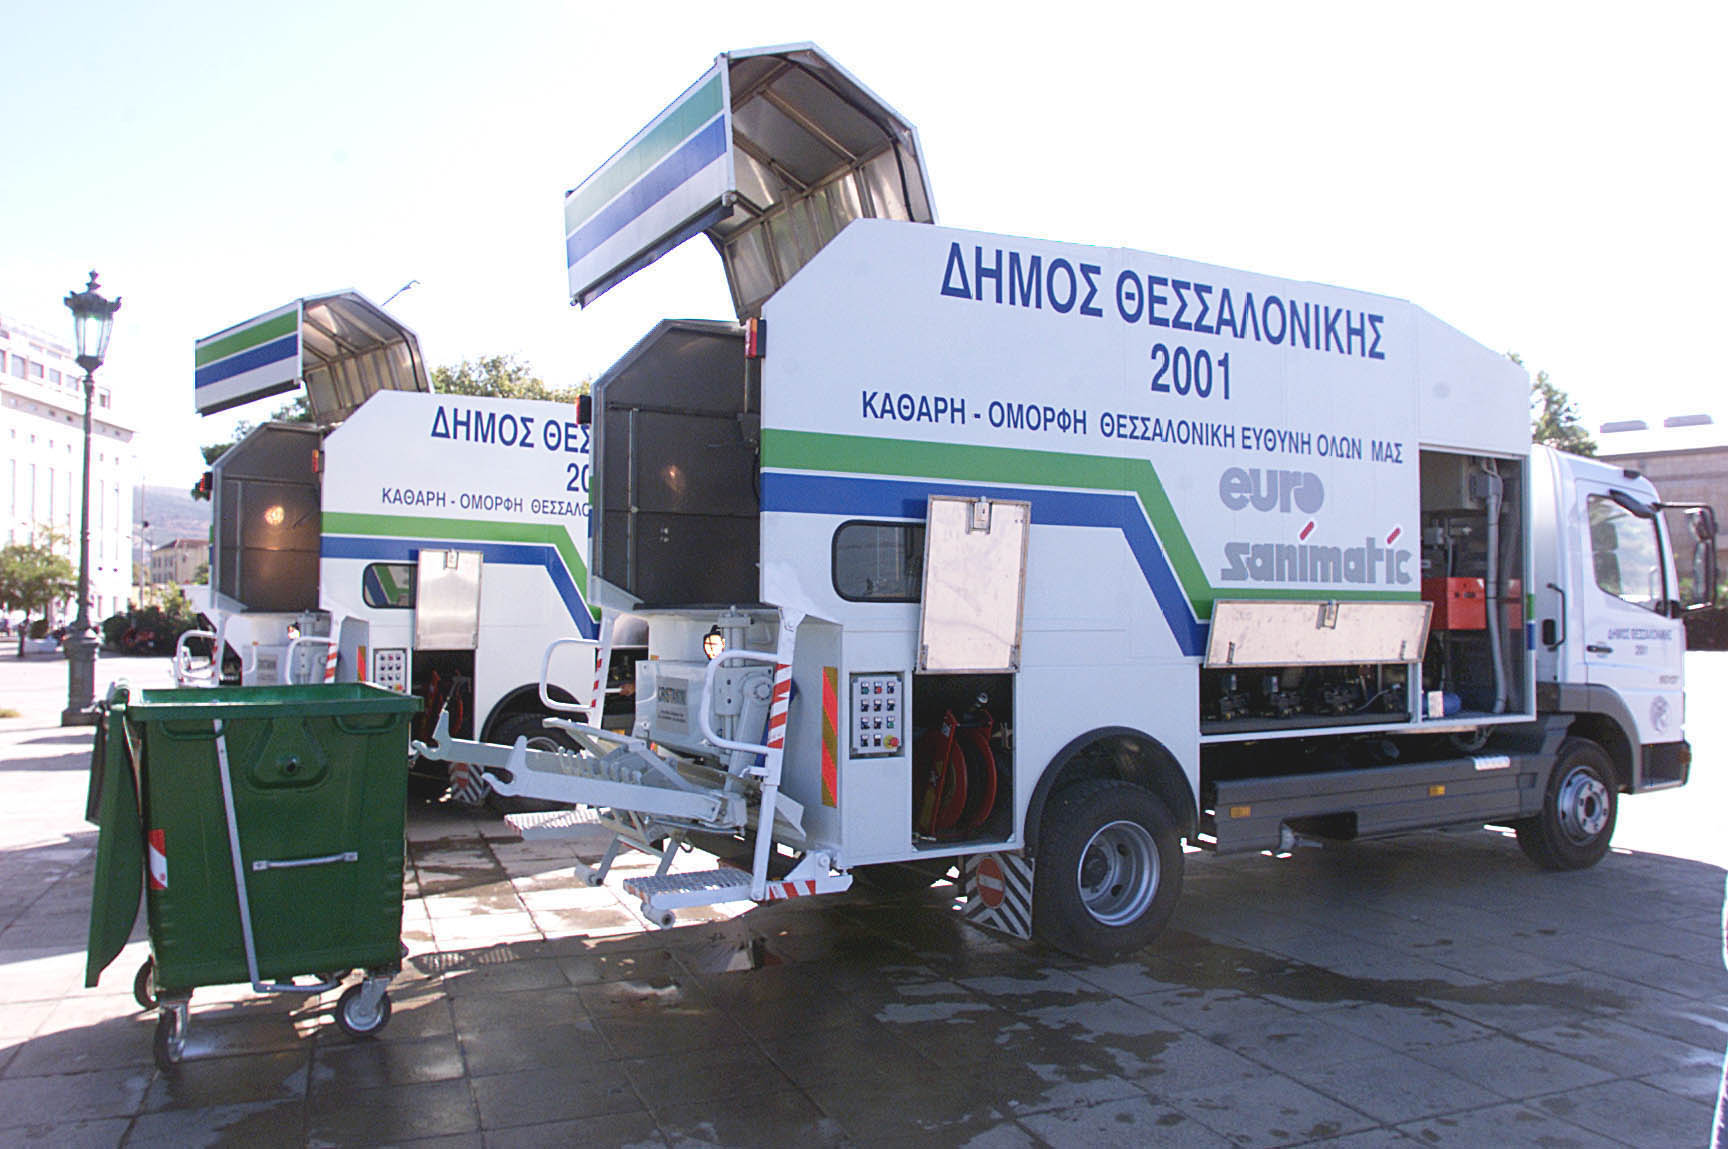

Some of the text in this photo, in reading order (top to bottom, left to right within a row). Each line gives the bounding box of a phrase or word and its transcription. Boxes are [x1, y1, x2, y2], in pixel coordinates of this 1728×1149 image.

[940, 241, 1387, 361] ΔΗΜΟΣ ΘΕΣΣΑΛΟΝΙΚΗΣ
[1150, 342, 1232, 401] 2001
[430, 405, 536, 450] ΔΗΜΟΣ
[861, 390, 967, 426] ΚΑΘΑΡΗ
[988, 400, 1088, 436] ΟΜΟΡΦΗ
[1100, 411, 1236, 449] ΘΕΣΣΑΛΟΝΙΚΗ
[1240, 425, 1312, 456] ΕΥΘΥΝΗ
[1315, 432, 1364, 460] ΟΛΩΝ
[1370, 440, 1404, 464] ΜΑΣ
[381, 487, 446, 508] ΚΑΘΑΡΗ
[459, 493, 523, 513] ΟΜΟΡΦΗ
[1218, 464, 1326, 515] euro
[1219, 519, 1414, 586] sanimatic
